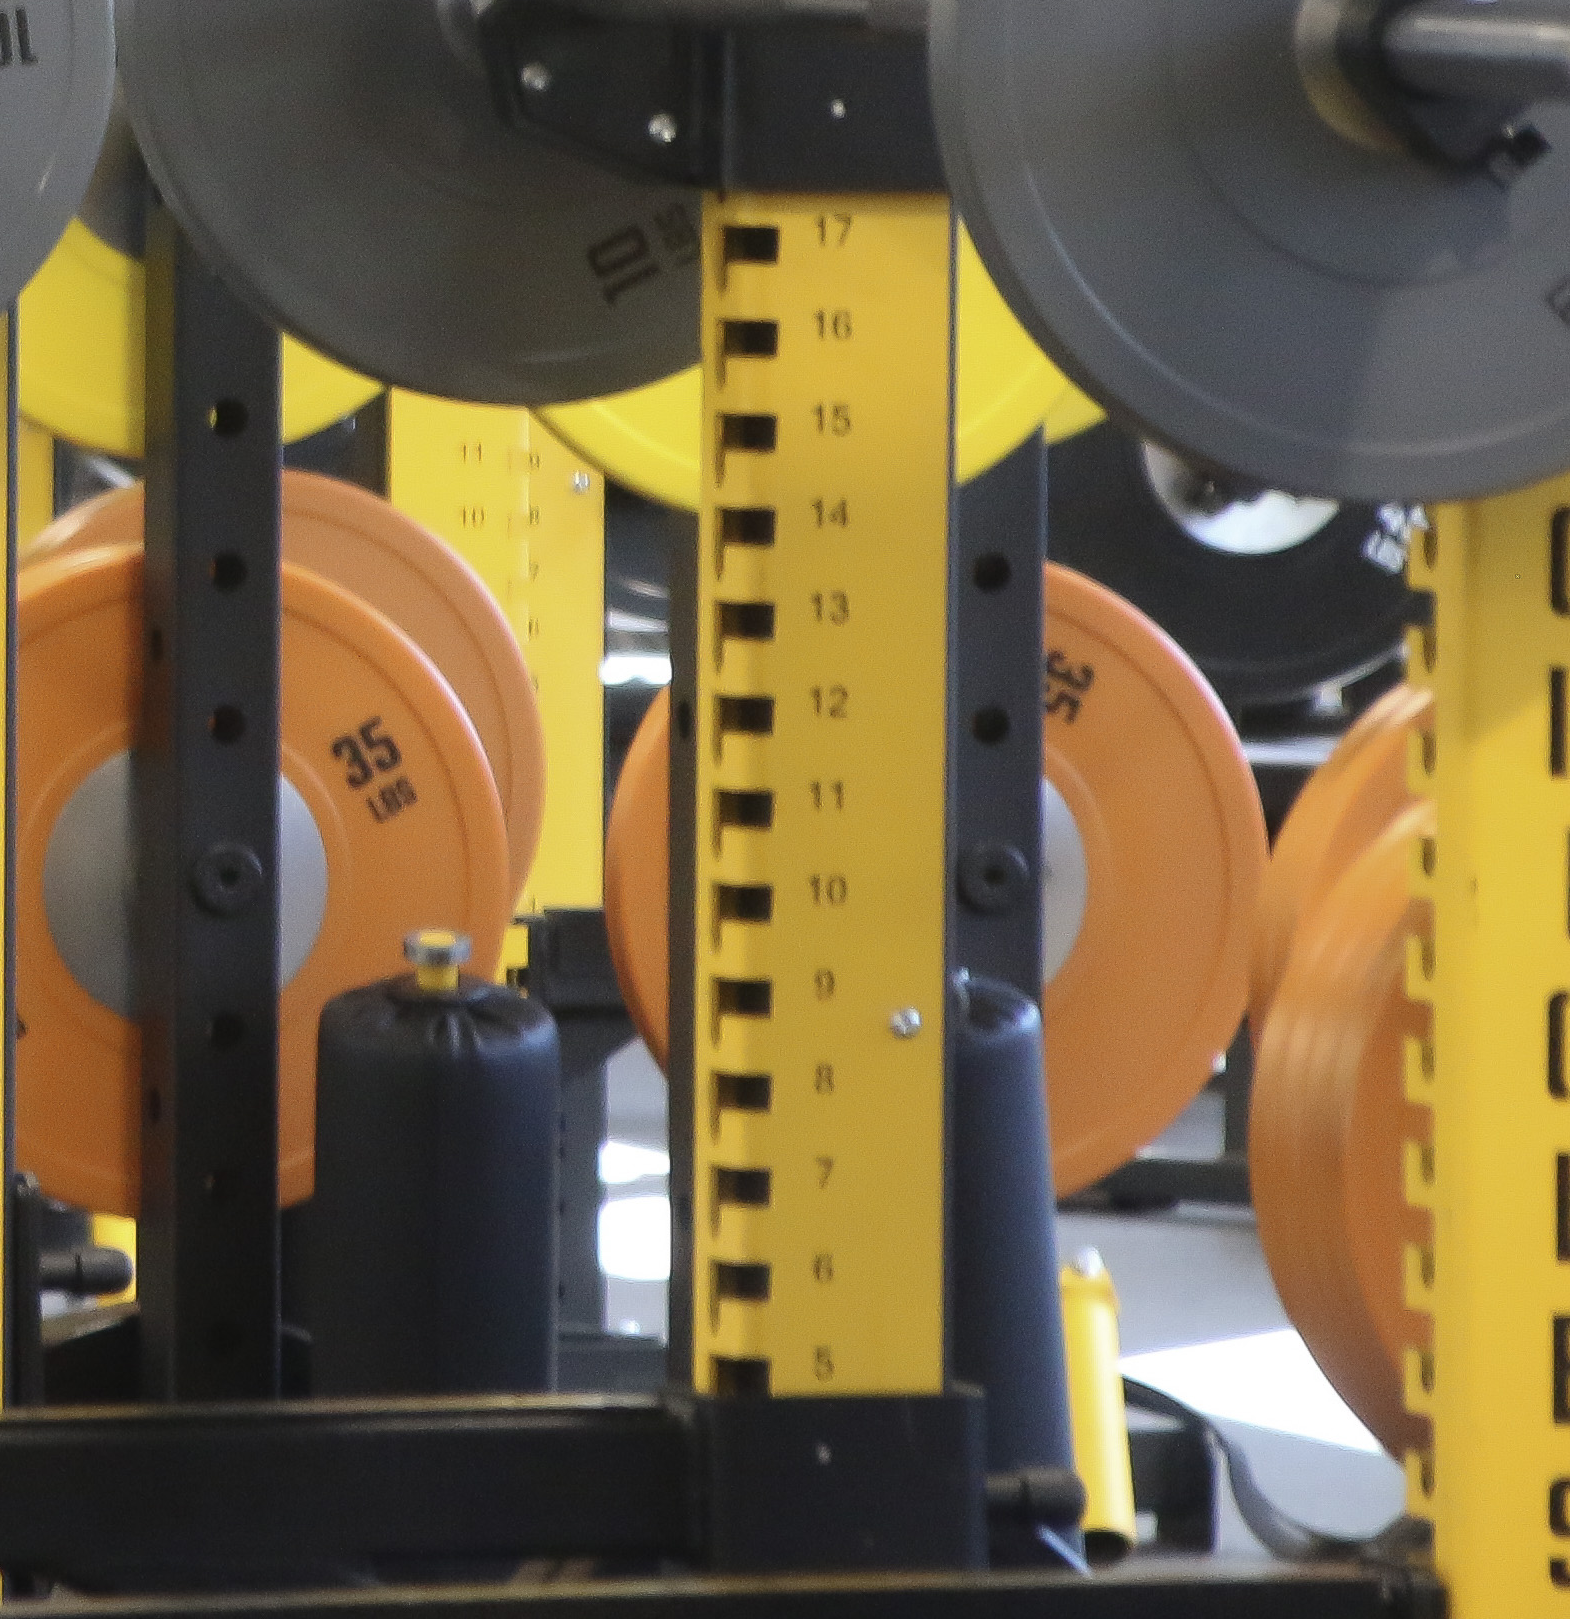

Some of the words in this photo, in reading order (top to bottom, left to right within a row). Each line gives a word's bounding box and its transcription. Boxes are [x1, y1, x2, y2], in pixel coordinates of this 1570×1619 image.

[813, 216, 853, 246] 17
[587, 225, 659, 305] 10
[813, 311, 852, 341] 16
[812, 406, 851, 435] 15
[811, 500, 849, 529] 14
[811, 593, 849, 623] 13
[810, 687, 848, 717] 12
[330, 716, 402, 791] 35
[810, 782, 845, 810] 11
[809, 876, 847, 905] 10
[814, 970, 835, 999] 9
[814, 1064, 834, 1093] 8
[815, 1159, 834, 1188] 7
[813, 1253, 833, 1282] 6
[813, 1348, 834, 1378] 5
